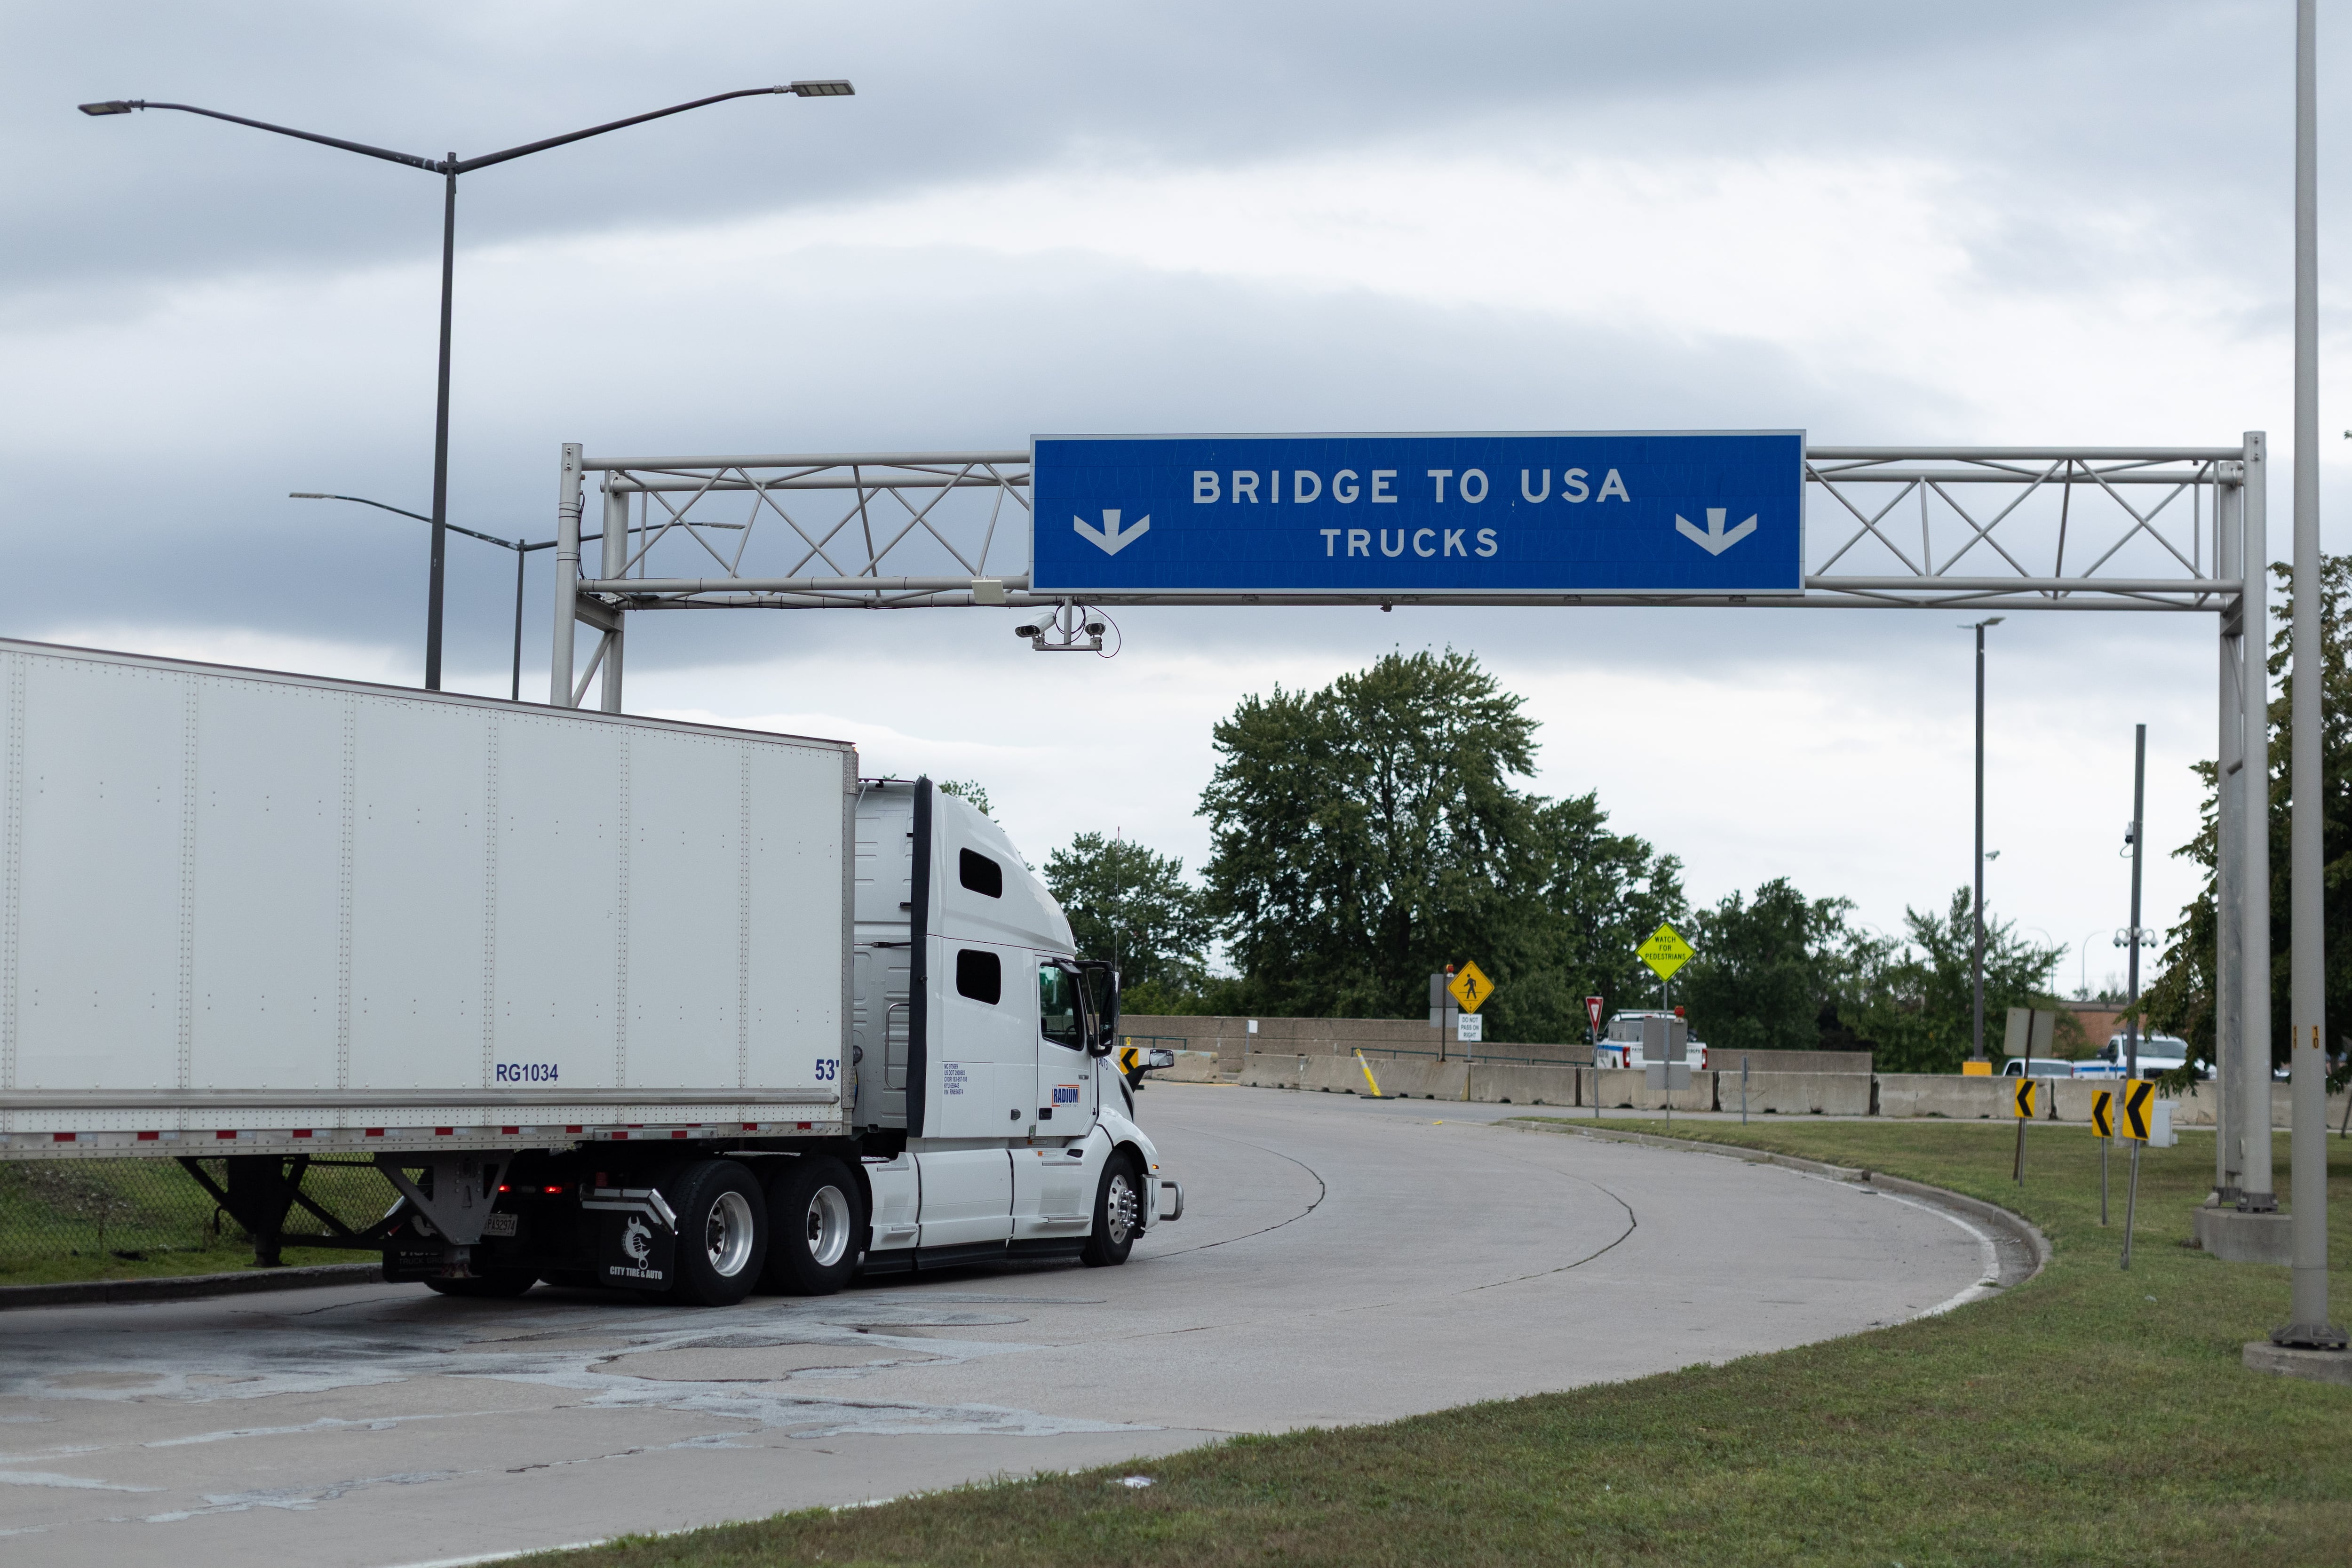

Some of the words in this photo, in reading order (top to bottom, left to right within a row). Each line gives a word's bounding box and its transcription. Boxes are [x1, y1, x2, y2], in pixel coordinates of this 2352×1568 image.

[1193, 469, 1397, 504] BRIDGE
[1427, 469, 1488, 503] TO
[1521, 468, 1630, 503] USA
[1320, 528, 1498, 557] TRUCKS
[496, 1064, 558, 1082] RG1034
[815, 1059, 840, 1081] 53'
[1053, 1088, 1078, 1103] RADIUM
[610, 1266, 625, 1275] CITY
[626, 1267, 640, 1277] TIRE
[646, 1269, 662, 1280] AUTO
